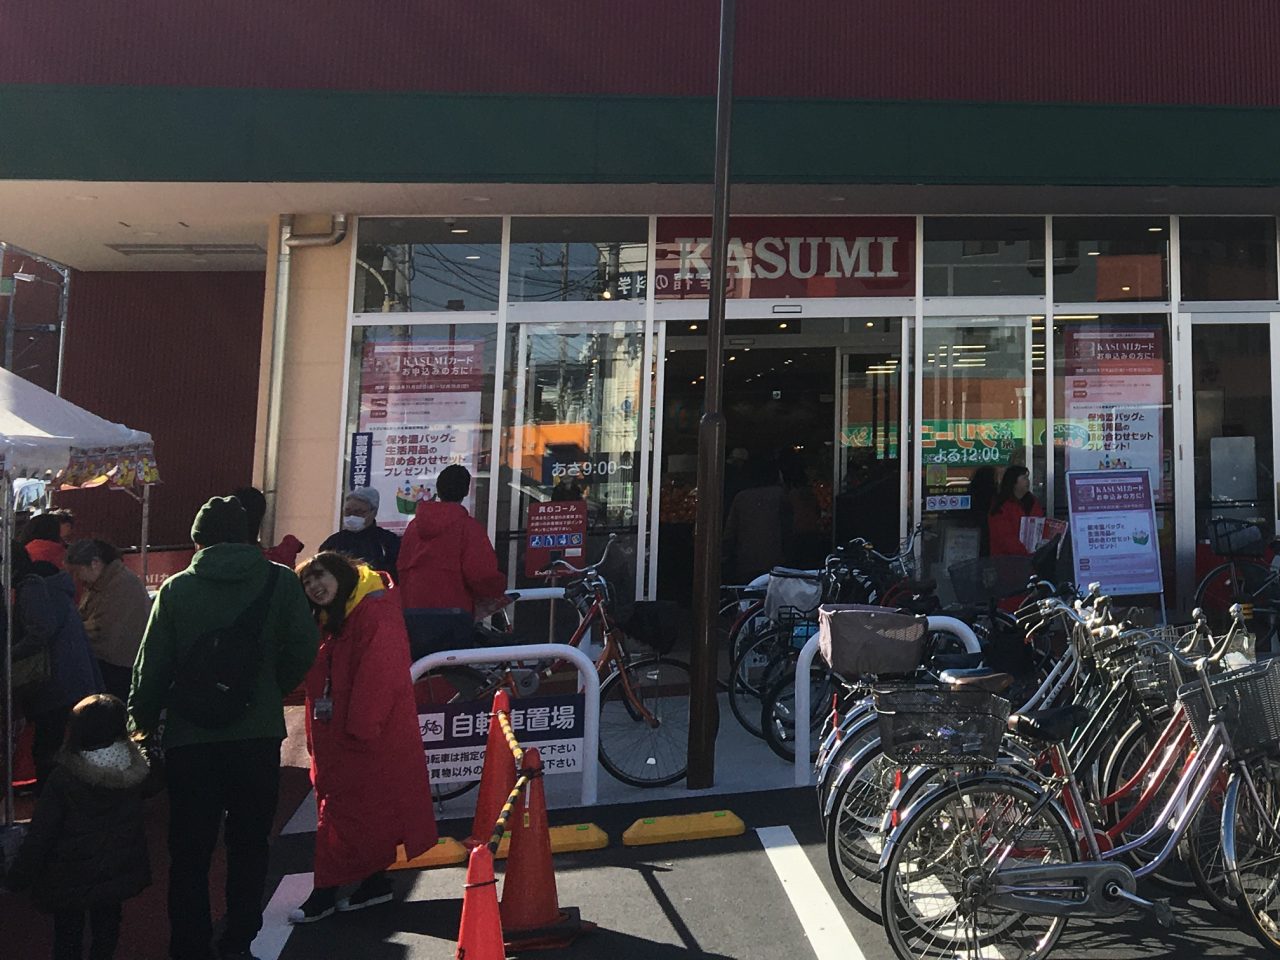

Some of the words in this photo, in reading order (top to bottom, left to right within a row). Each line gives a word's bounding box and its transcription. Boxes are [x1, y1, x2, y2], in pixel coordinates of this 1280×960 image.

[674, 236, 899, 279] KASUMI
[385, 445, 438, 456] 生活用品の
[933, 447, 999, 463] よる12:00
[384, 455, 466, 467] 詰め合わせセット
